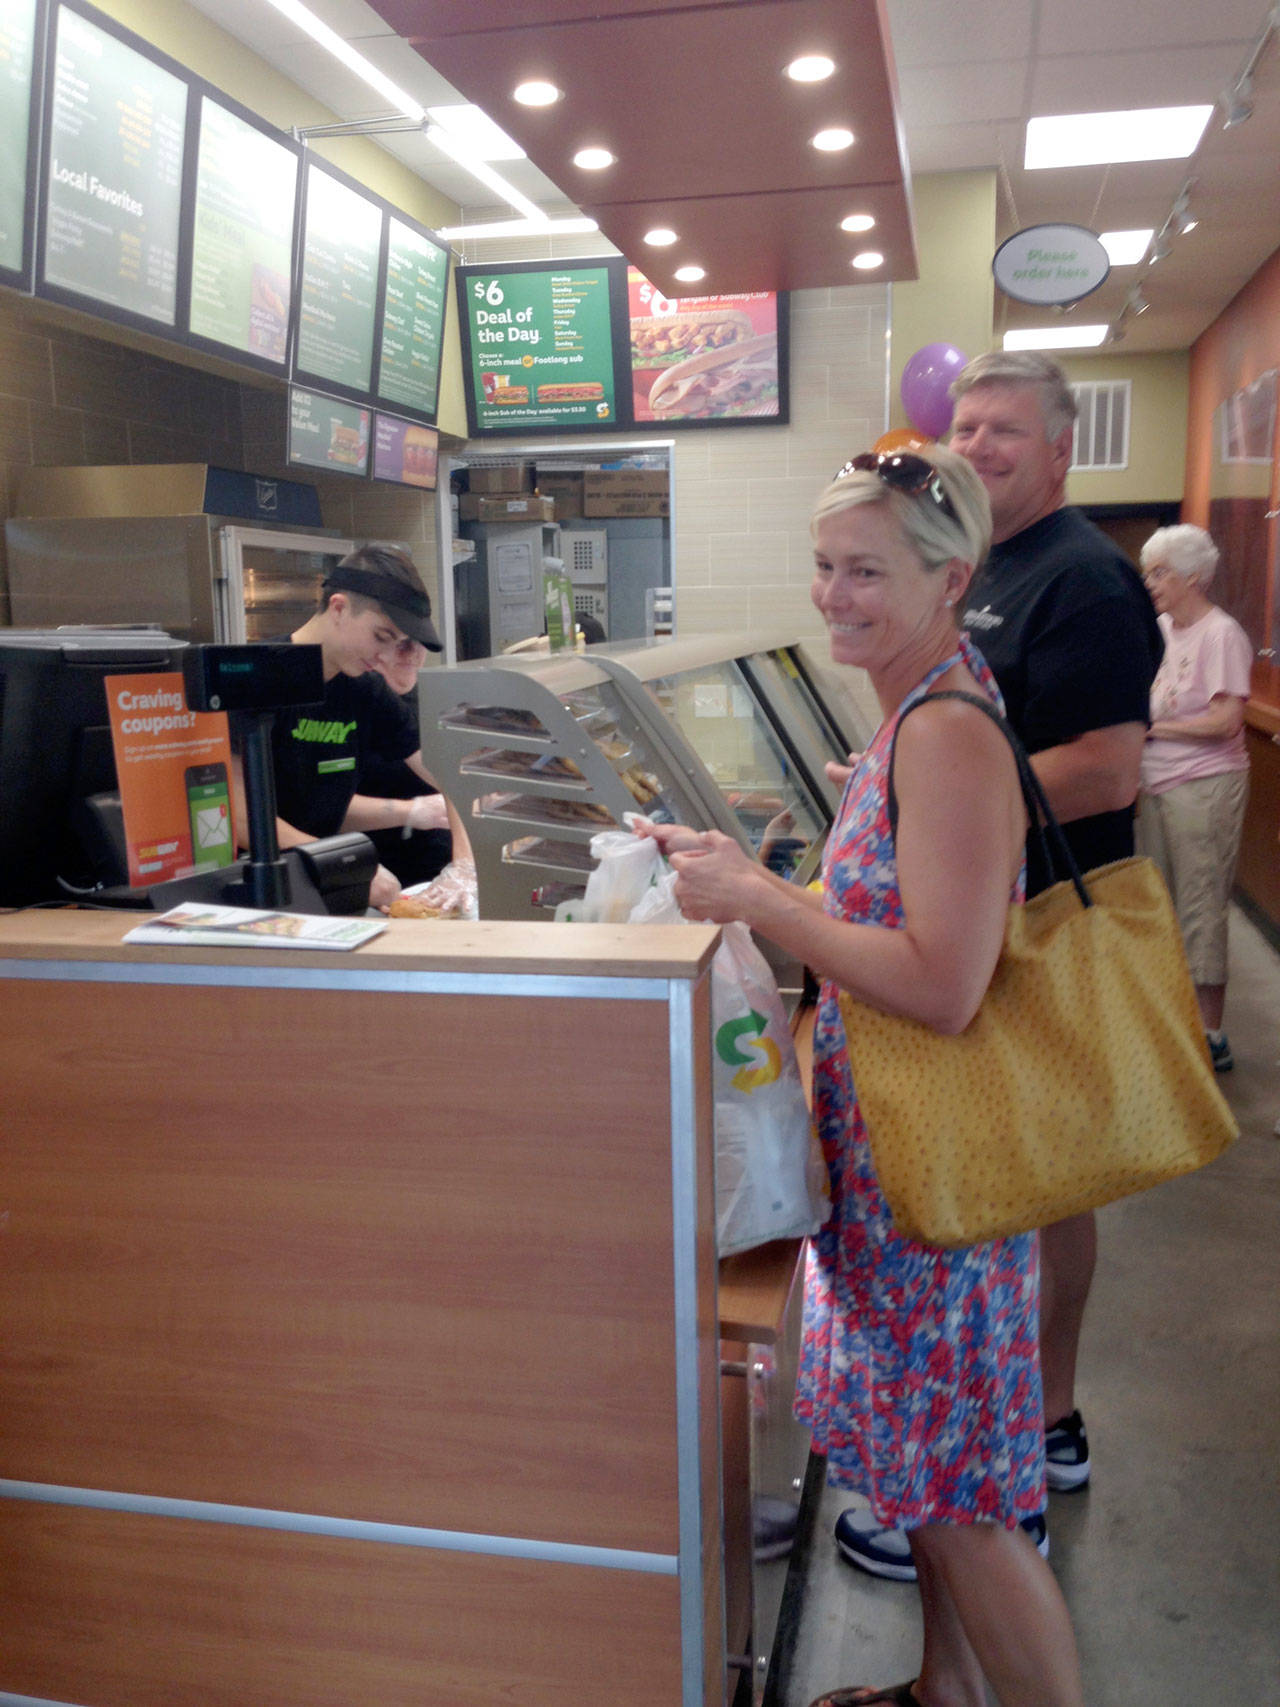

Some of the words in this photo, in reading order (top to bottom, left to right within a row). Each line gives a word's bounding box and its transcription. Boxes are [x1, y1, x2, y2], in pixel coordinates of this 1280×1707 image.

[53, 159, 88, 191] Local
[90, 176, 144, 216] Favorites
[1027, 249, 1077, 261] Please
[1013, 267, 1051, 279] order
[1056, 266, 1089, 278] here
[474, 280, 504, 306] $6
[476, 308, 512, 325] Deal
[515, 307, 533, 322] of
[478, 329, 505, 343] the
[508, 328, 540, 344] Day
[479, 359, 502, 367] 6-inch
[534, 356, 568, 364] Footlong
[569, 354, 584, 363] sub
[117, 689, 183, 711] Craving
[121, 711, 196, 736] coupons?
